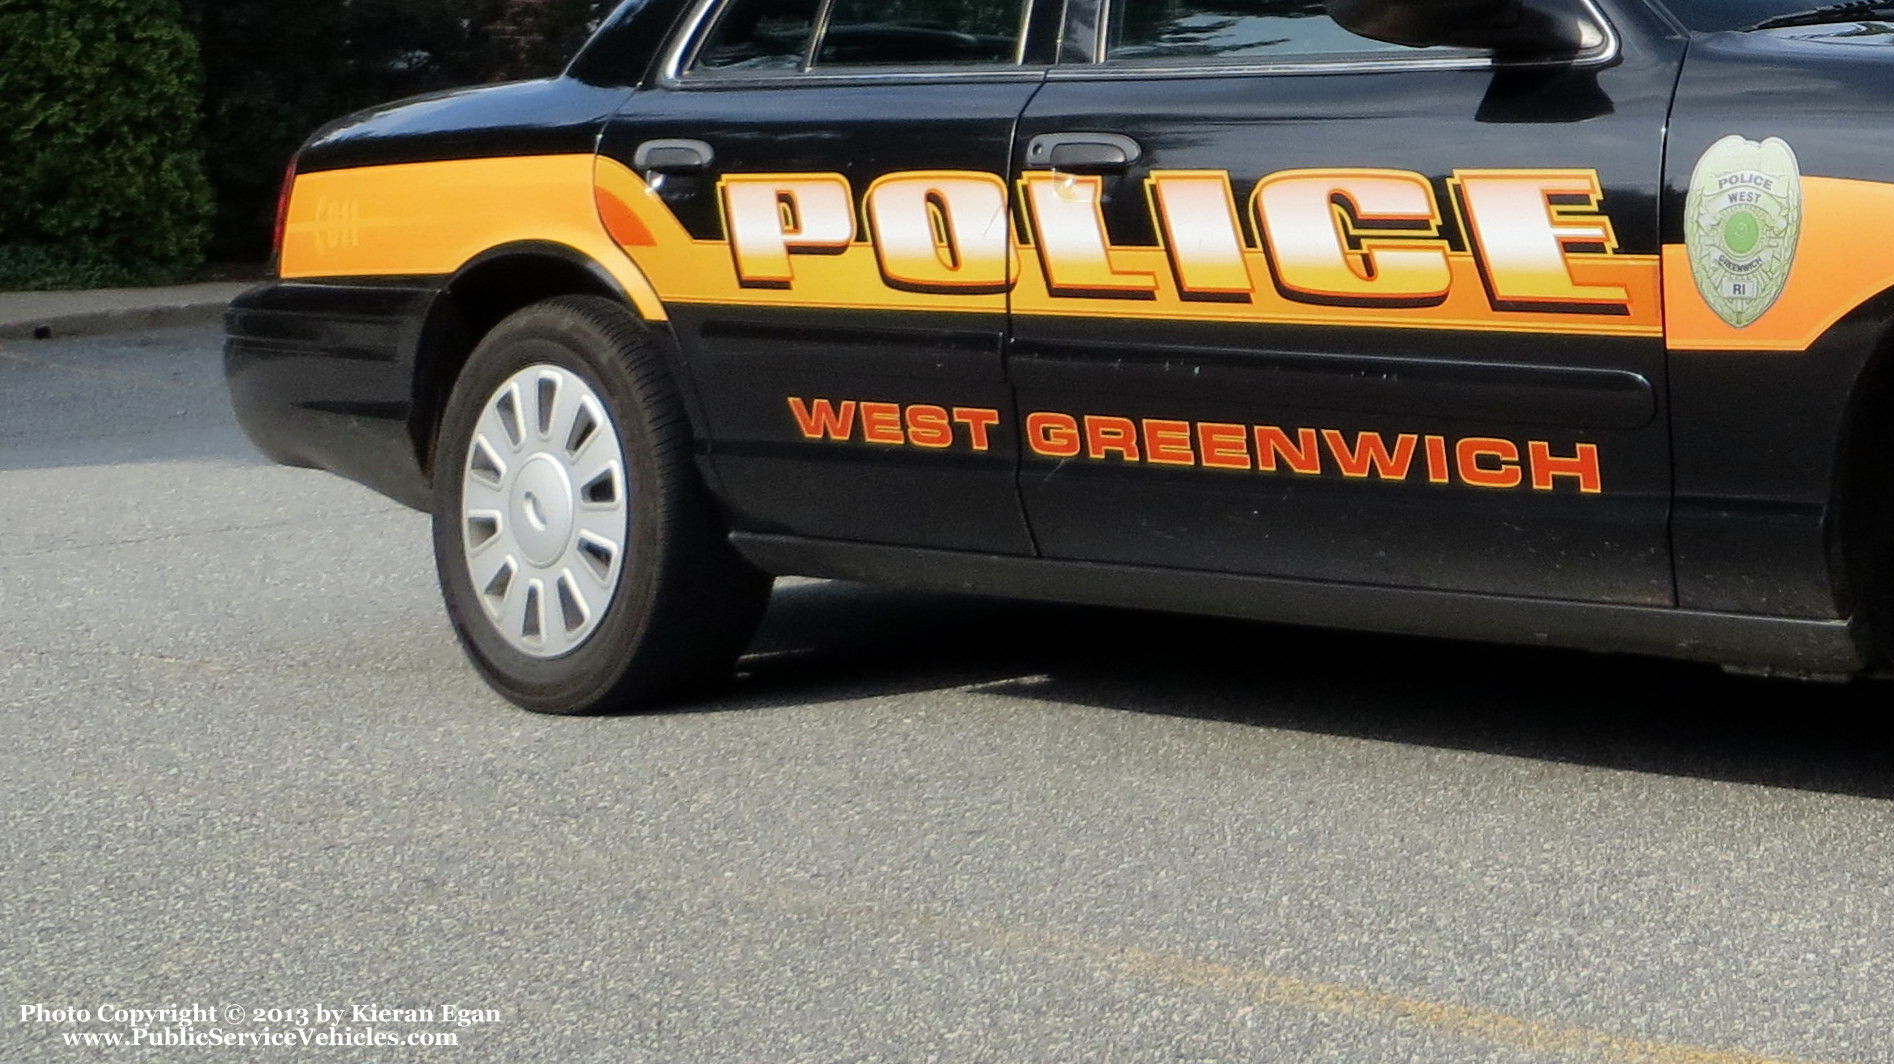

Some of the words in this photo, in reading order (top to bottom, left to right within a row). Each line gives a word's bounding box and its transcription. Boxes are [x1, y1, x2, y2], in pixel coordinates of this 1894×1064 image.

[1719, 175, 1773, 190] POLICE
[1728, 192, 1761, 204] WEST
[716, 168, 1633, 317] POLICE
[1718, 255, 1763, 272] GREENWICH
[1733, 284, 1746, 295] RI
[787, 396, 1000, 452] WEST
[1026, 411, 1603, 494] GREENWICH
